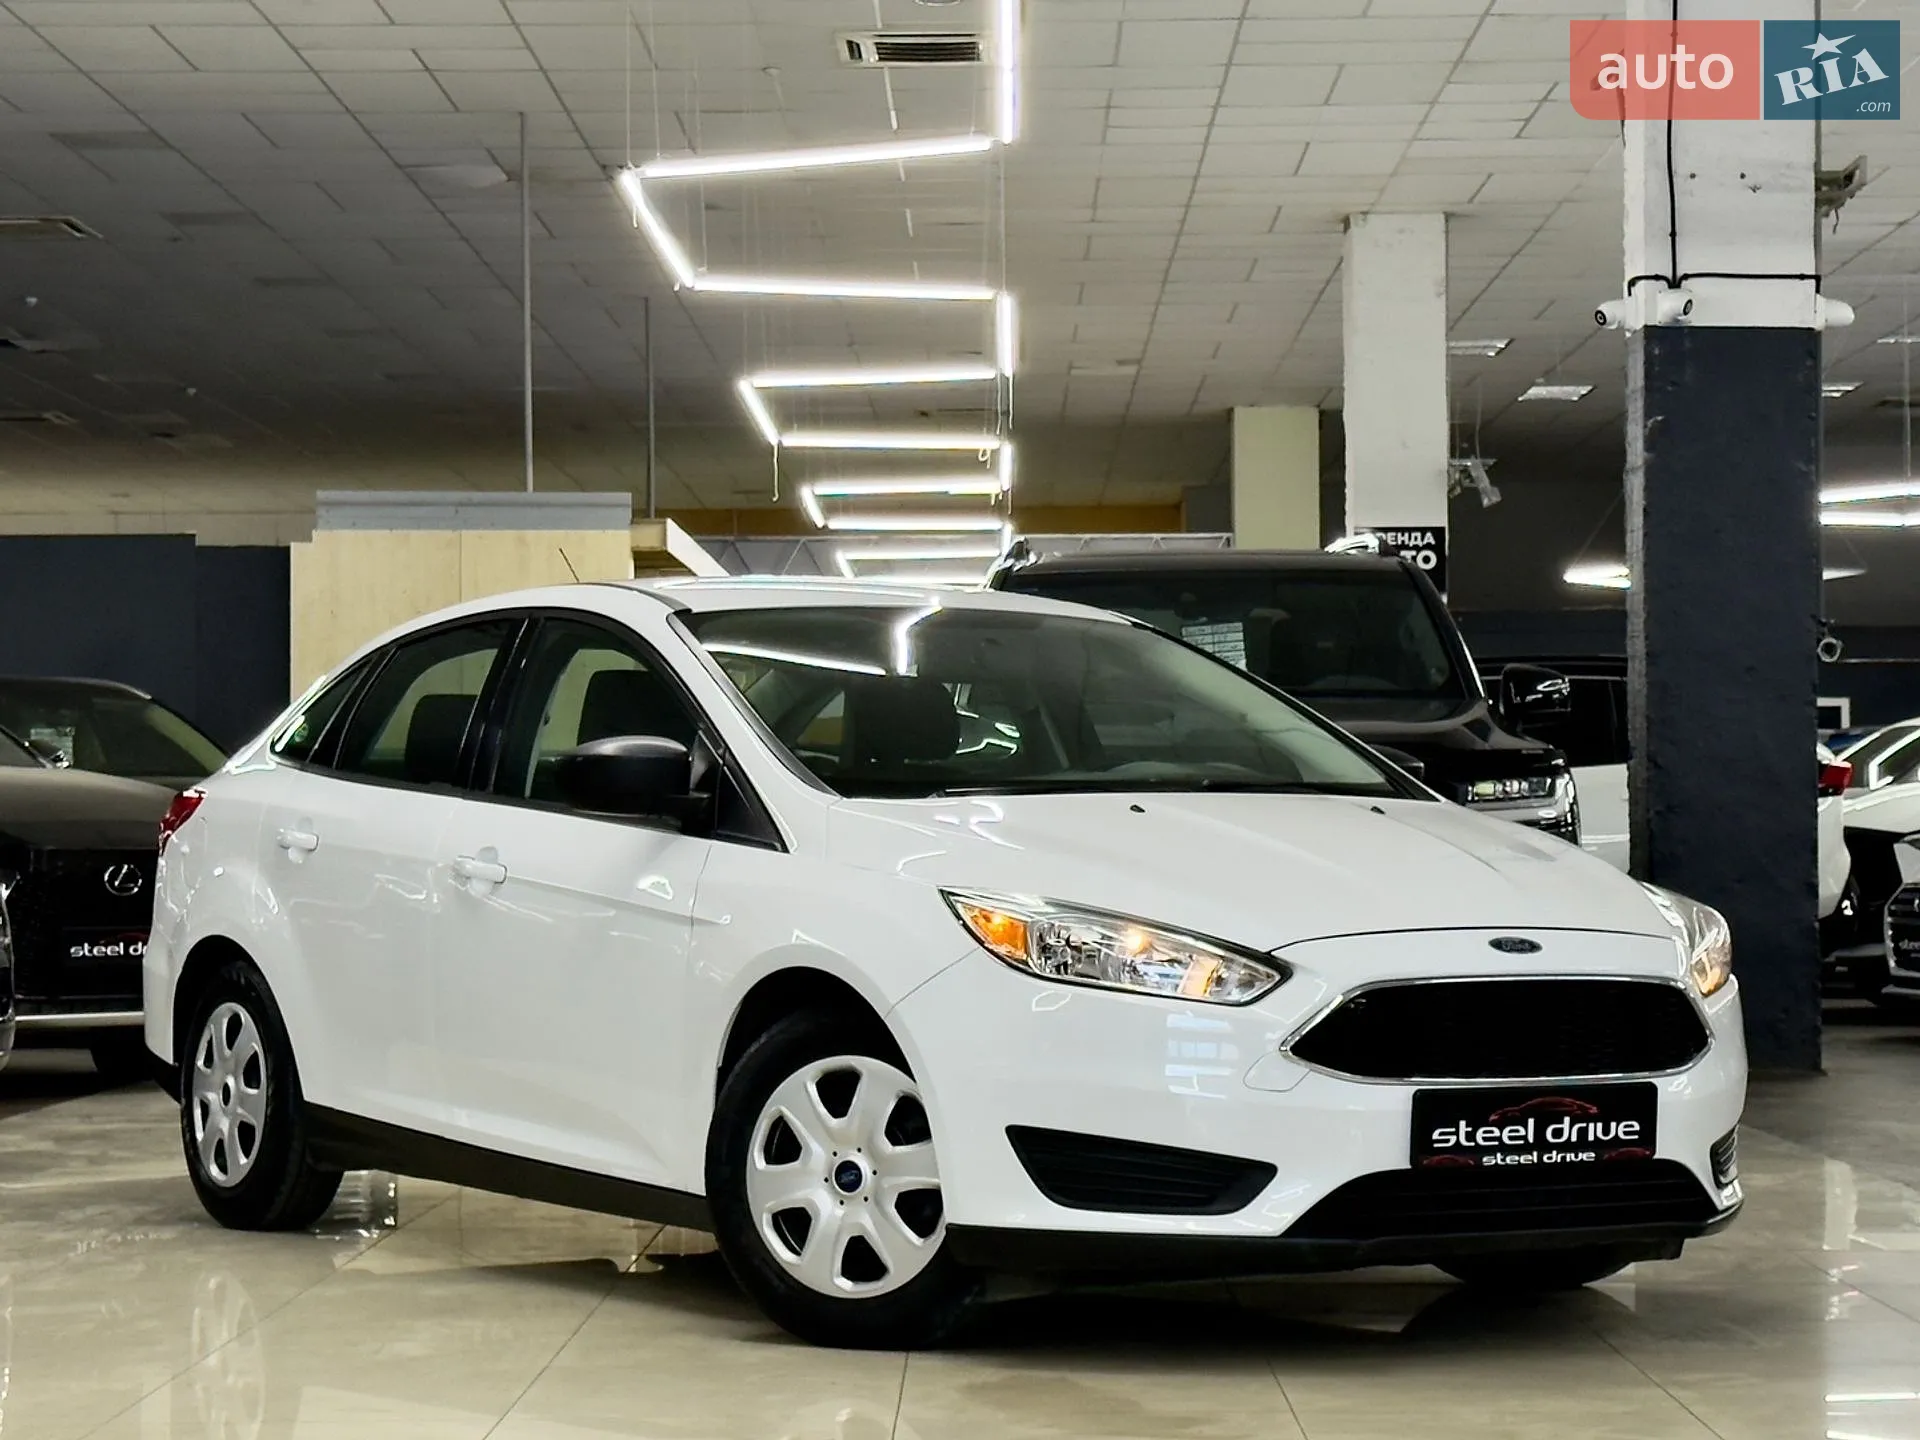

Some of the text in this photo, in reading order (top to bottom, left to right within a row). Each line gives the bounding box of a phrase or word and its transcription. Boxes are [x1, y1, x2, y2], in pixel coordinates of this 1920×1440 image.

[69, 941, 124, 958] steel
[1431, 1116, 1641, 1148] steel drive
[1482, 1149, 1596, 1166] steel drive
